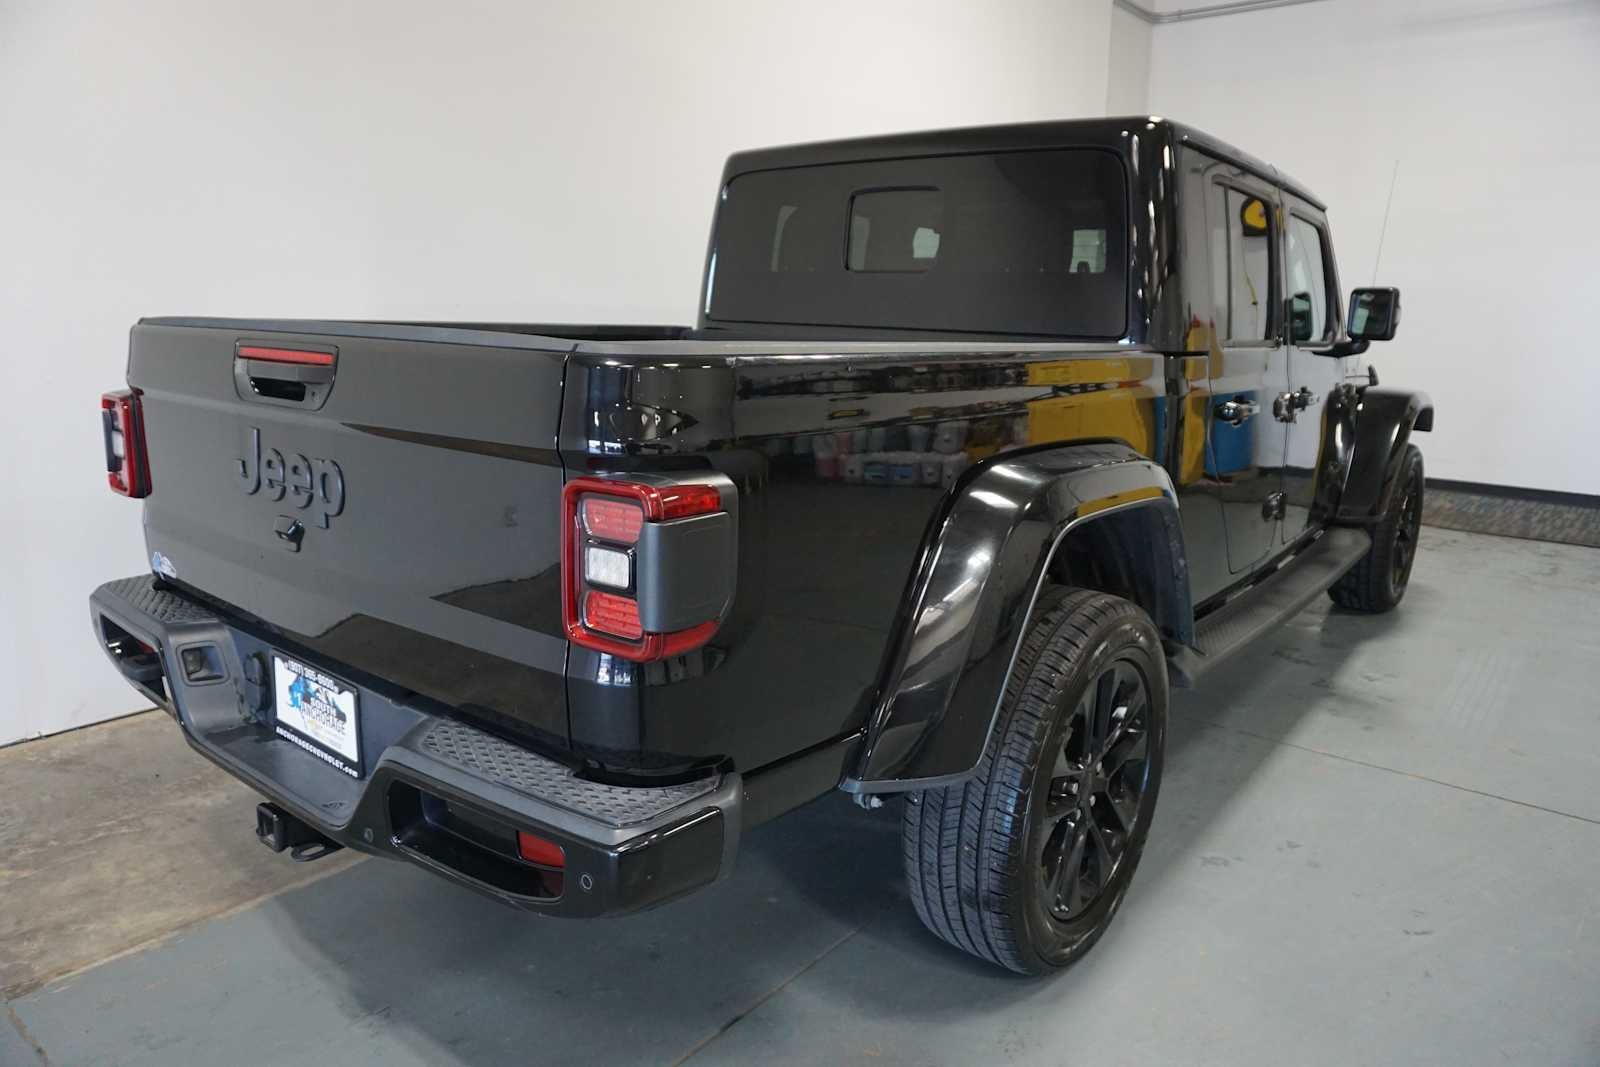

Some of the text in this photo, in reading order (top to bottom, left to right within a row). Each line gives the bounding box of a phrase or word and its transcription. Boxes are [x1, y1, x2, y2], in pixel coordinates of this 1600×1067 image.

[237, 426, 345, 529] Jeep
[301, 702, 346, 735] ANCHORAGE
[310, 697, 336, 718] SOUTH
